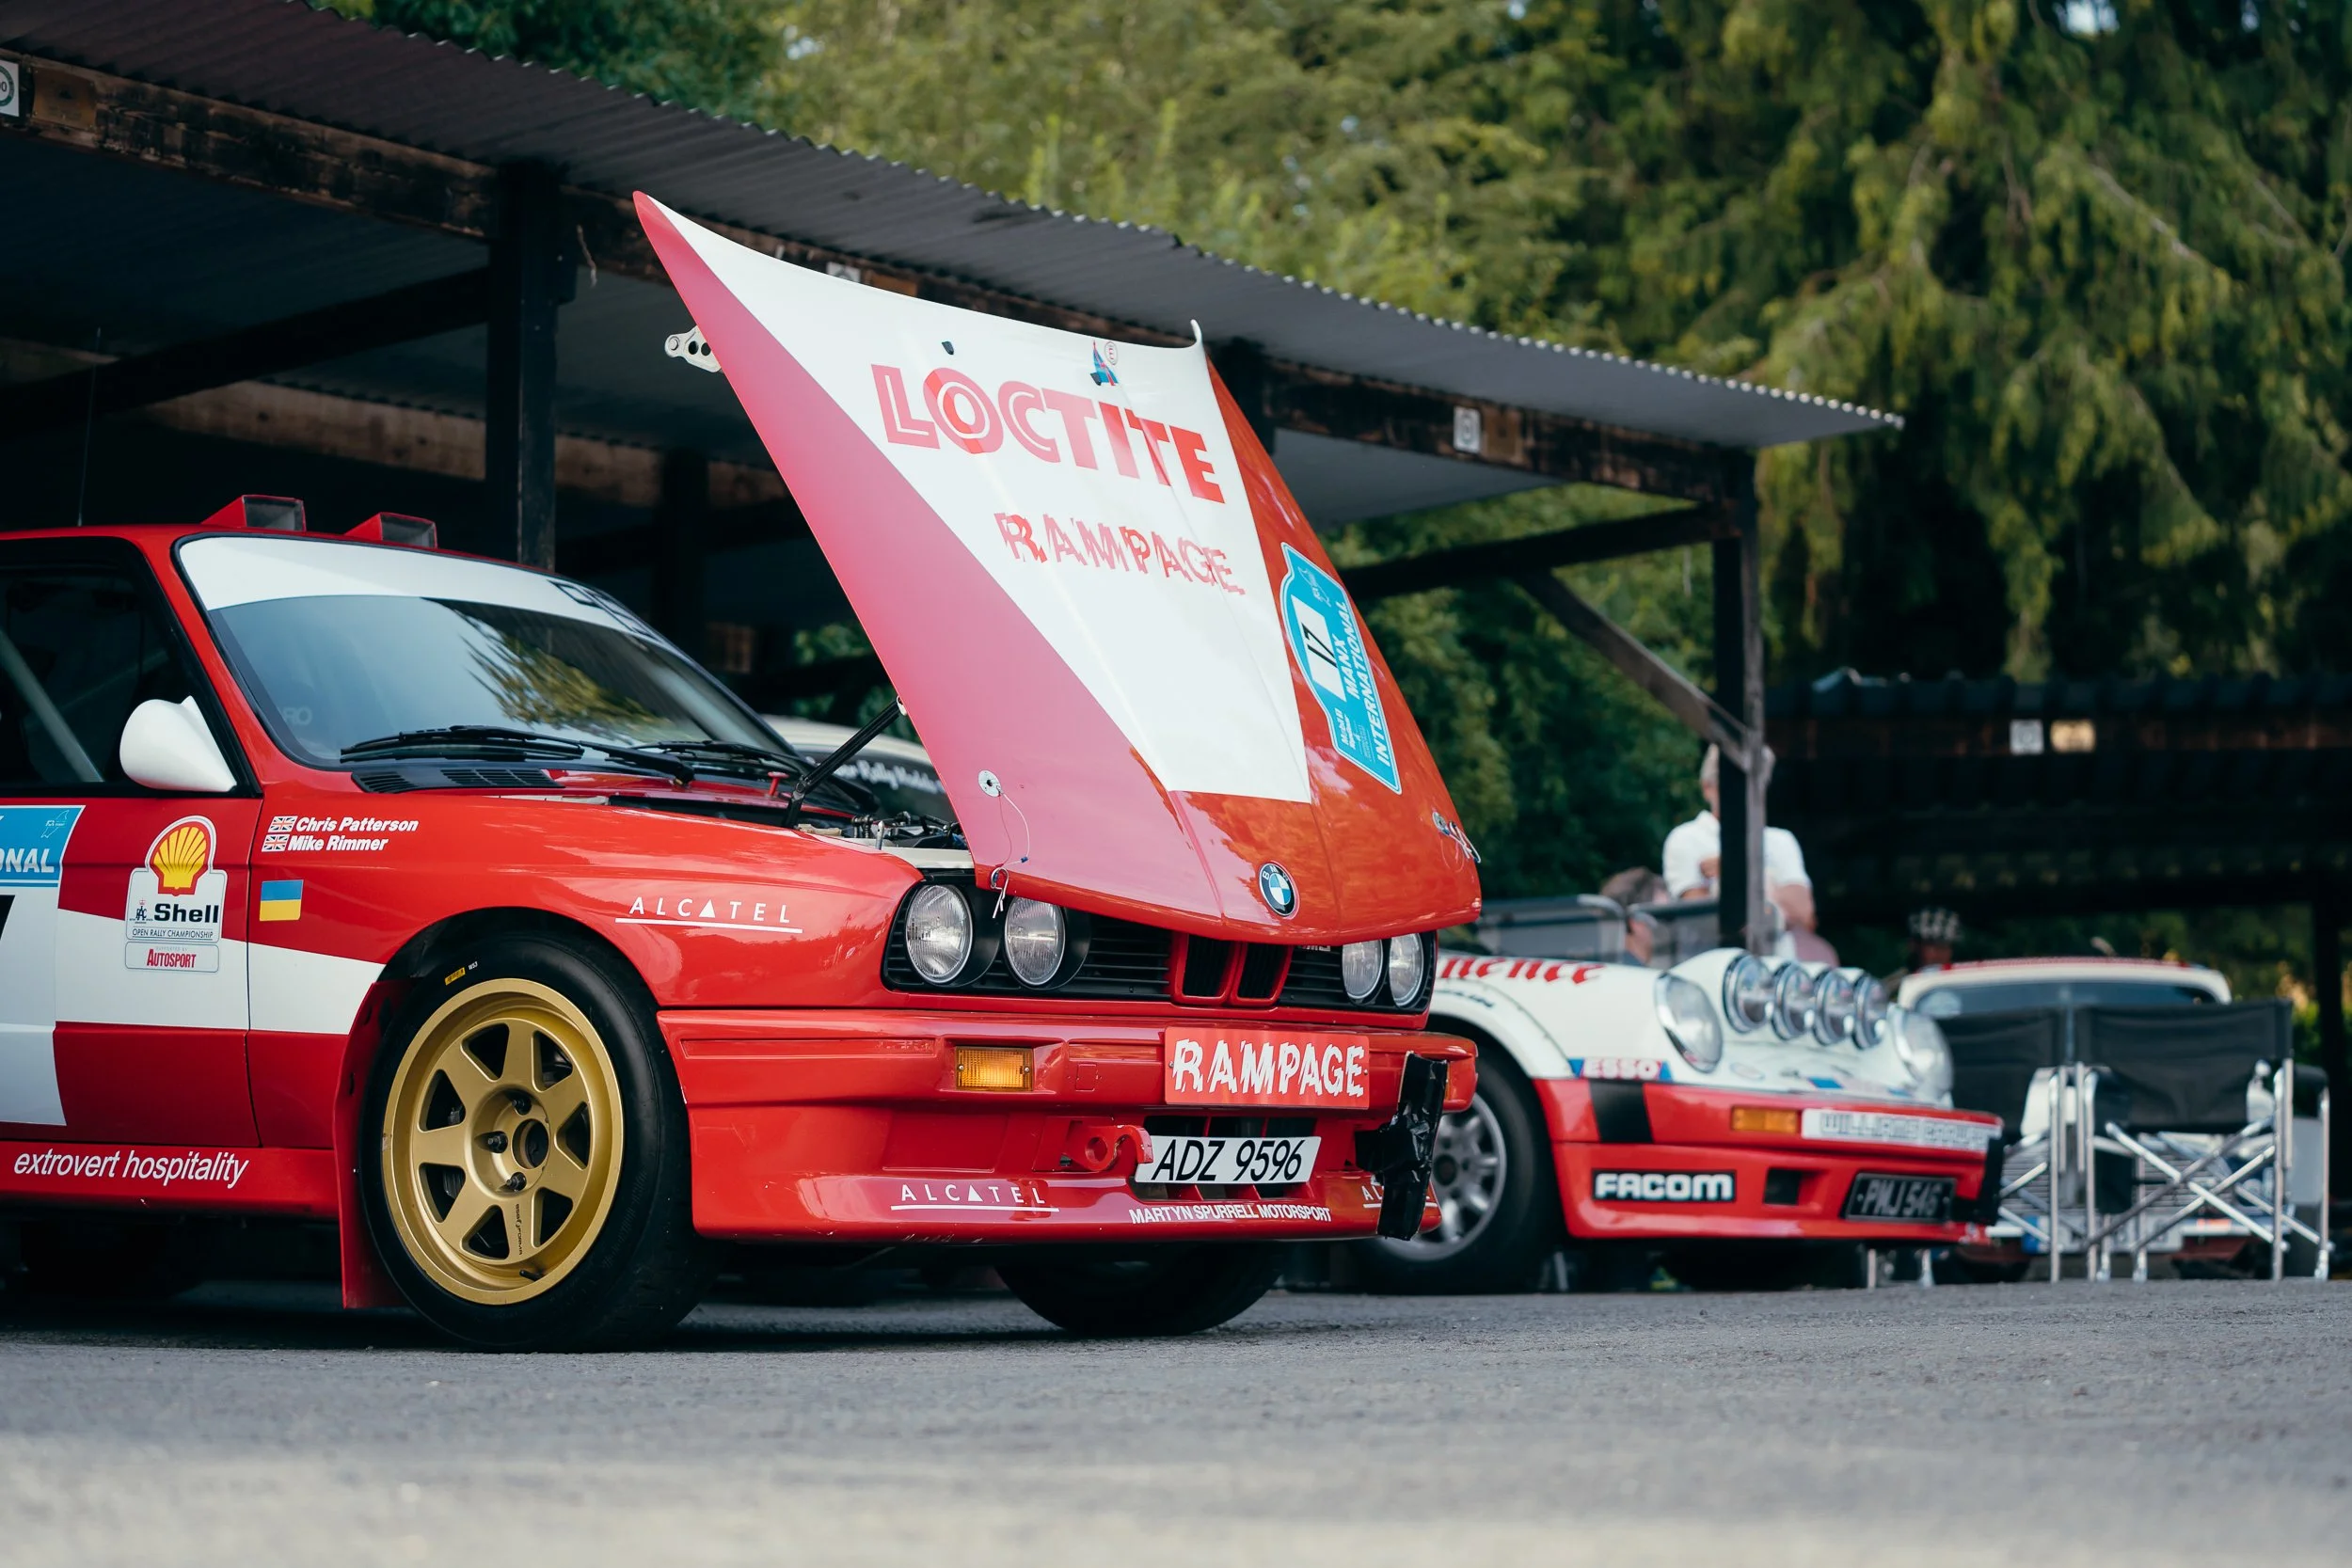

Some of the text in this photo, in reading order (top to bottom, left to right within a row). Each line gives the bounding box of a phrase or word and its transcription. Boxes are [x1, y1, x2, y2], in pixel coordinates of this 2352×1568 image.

[870, 364, 1226, 504] LOCTITE
[993, 513, 1246, 595] RAMPAGE
[1301, 623, 1339, 668] 17
[1332, 633, 1360, 700] MANX
[1335, 601, 1391, 767] INTERNATIONAL
[295, 816, 420, 832] Chris Patterson
[287, 835, 389, 851] Mike Rimmer
[153, 903, 219, 924] Shell
[629, 896, 790, 924] ALCATEL
[167, 929, 214, 939] CHAMPIONSHIP
[147, 949, 197, 968] AUTOSPORT
[1172, 1038, 1364, 1098] RAMPAGE
[13, 1148, 250, 1189] extrovert hospitality
[1151, 1139, 1306, 1181] ADZ 9596
[901, 1184, 1046, 1204] ALCATEL
[1596, 1173, 1733, 1200] FACOM
[1128, 1204, 1332, 1224] MARTYN SPURRELL MOTORSPORT
